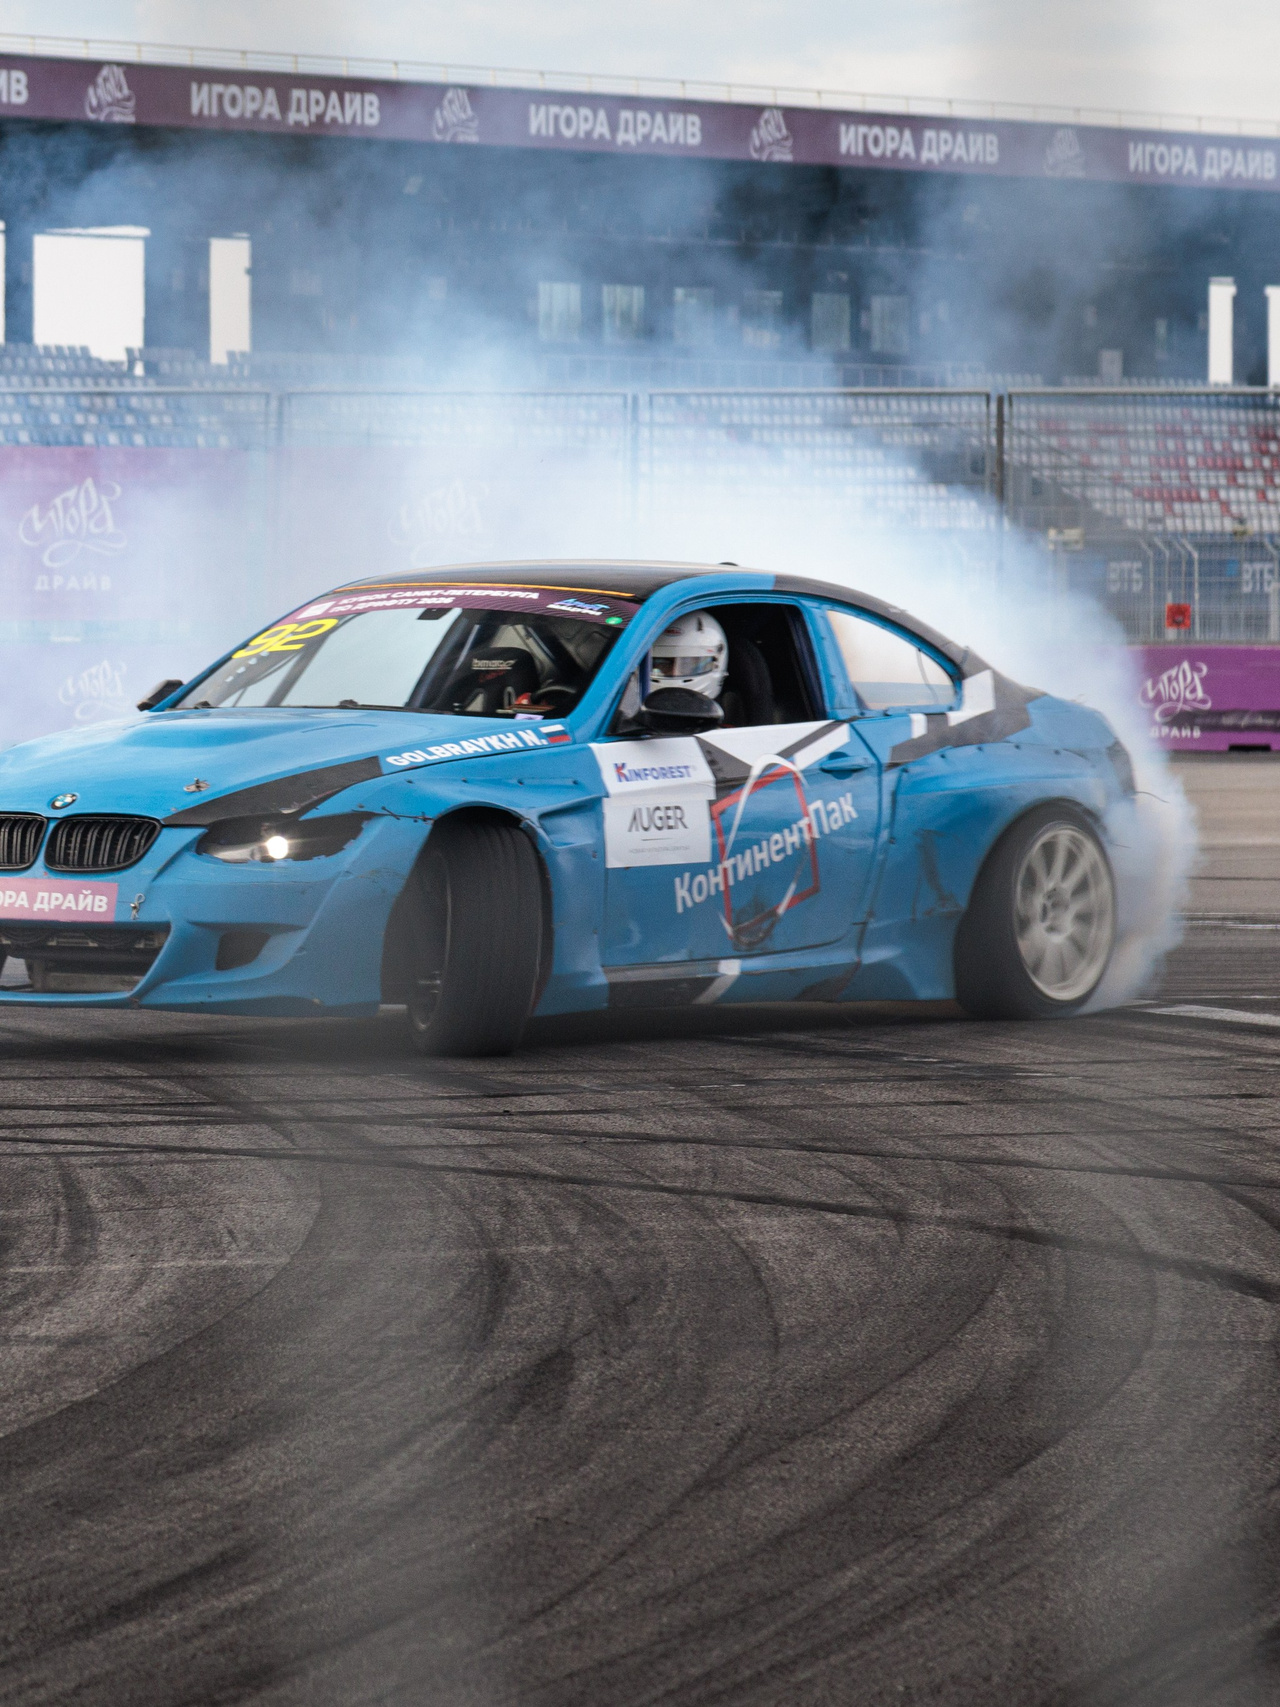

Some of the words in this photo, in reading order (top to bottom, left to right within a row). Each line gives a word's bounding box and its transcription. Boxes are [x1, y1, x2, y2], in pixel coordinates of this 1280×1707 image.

[190, 81, 282, 121] ИГОРА
[529, 103, 611, 140] ИГОРА
[839, 123, 916, 160] ИГОРА
[1128, 142, 1199, 176] ИГОРА
[1109, 560, 1143, 593] ВТБ
[231, 618, 339, 659] 92
[385, 732, 522, 766] GOLBRAYKH
[518, 729, 549, 747] N.
[627, 805, 689, 832] AUGER
[33, 889, 108, 912] ДРАЙВ
